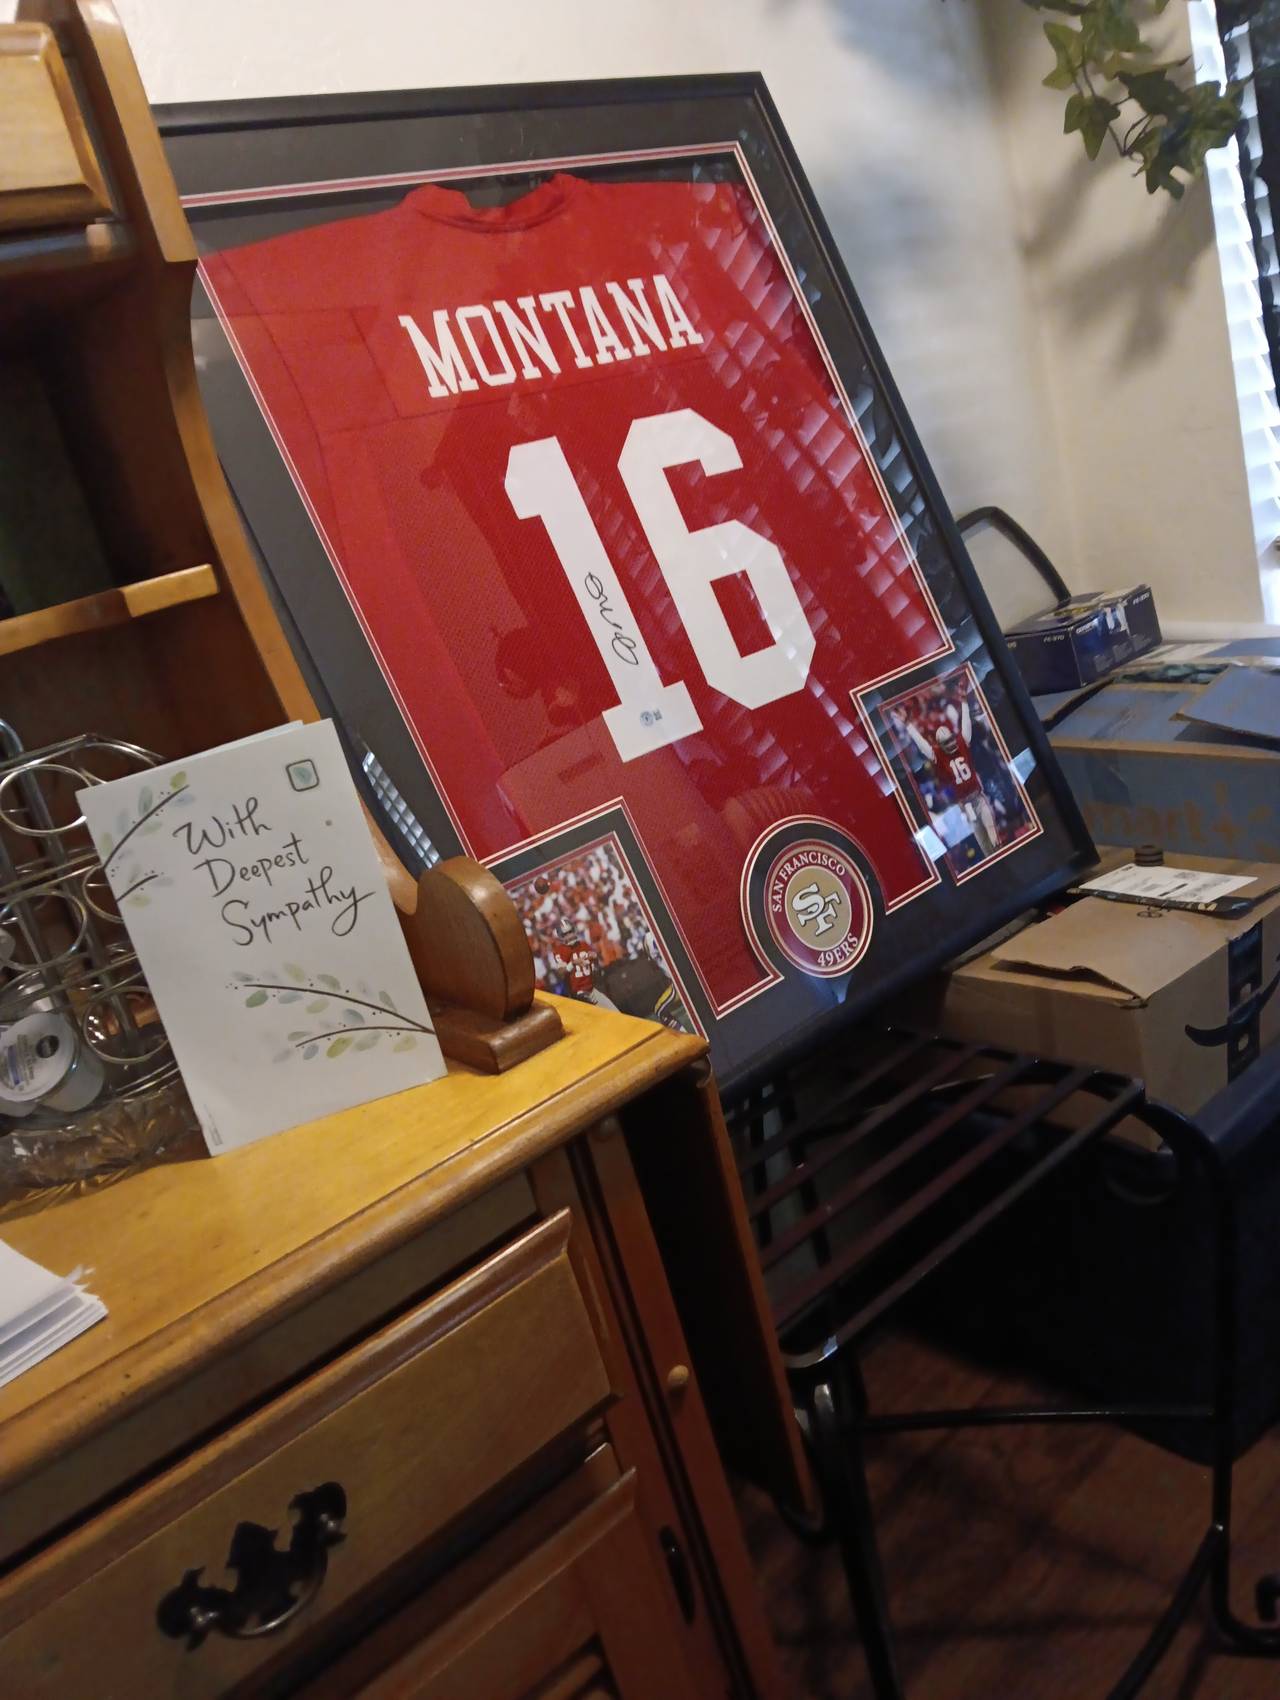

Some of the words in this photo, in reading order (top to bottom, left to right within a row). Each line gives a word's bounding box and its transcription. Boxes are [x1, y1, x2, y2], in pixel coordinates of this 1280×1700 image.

[398, 274, 704, 398] MONTANA
[504, 408, 817, 763] 16
[949, 757, 971, 784] 16
[172, 797, 272, 855] With
[193, 833, 309, 897] Deepest
[772, 881, 784, 912] SAN
[779, 852, 846, 881] FRANCISCO
[221, 866, 376, 946] Sympathy
[792, 882, 842, 936] SF
[817, 933, 859, 967] 49ERS
